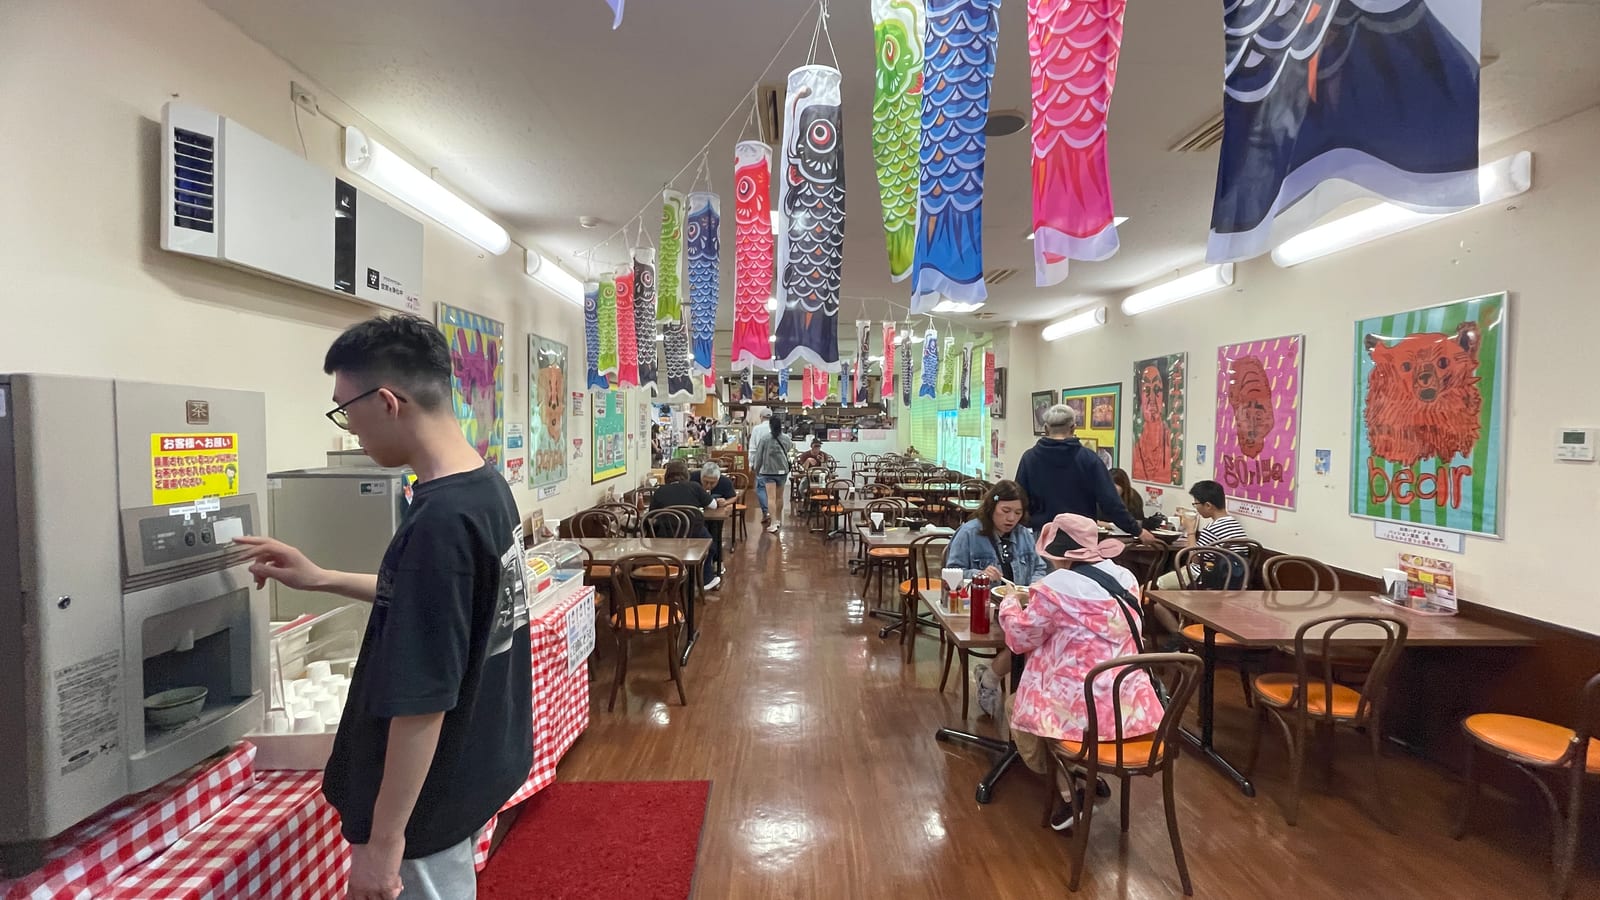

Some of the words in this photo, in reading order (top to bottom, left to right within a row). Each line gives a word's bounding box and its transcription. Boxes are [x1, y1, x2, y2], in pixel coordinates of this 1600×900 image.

[190, 403, 208, 419] 茶
[163, 437, 231, 450] お客様へお願い
[155, 465, 224, 479] お茶や水を入れるのは
[1367, 456, 1472, 509] bear
